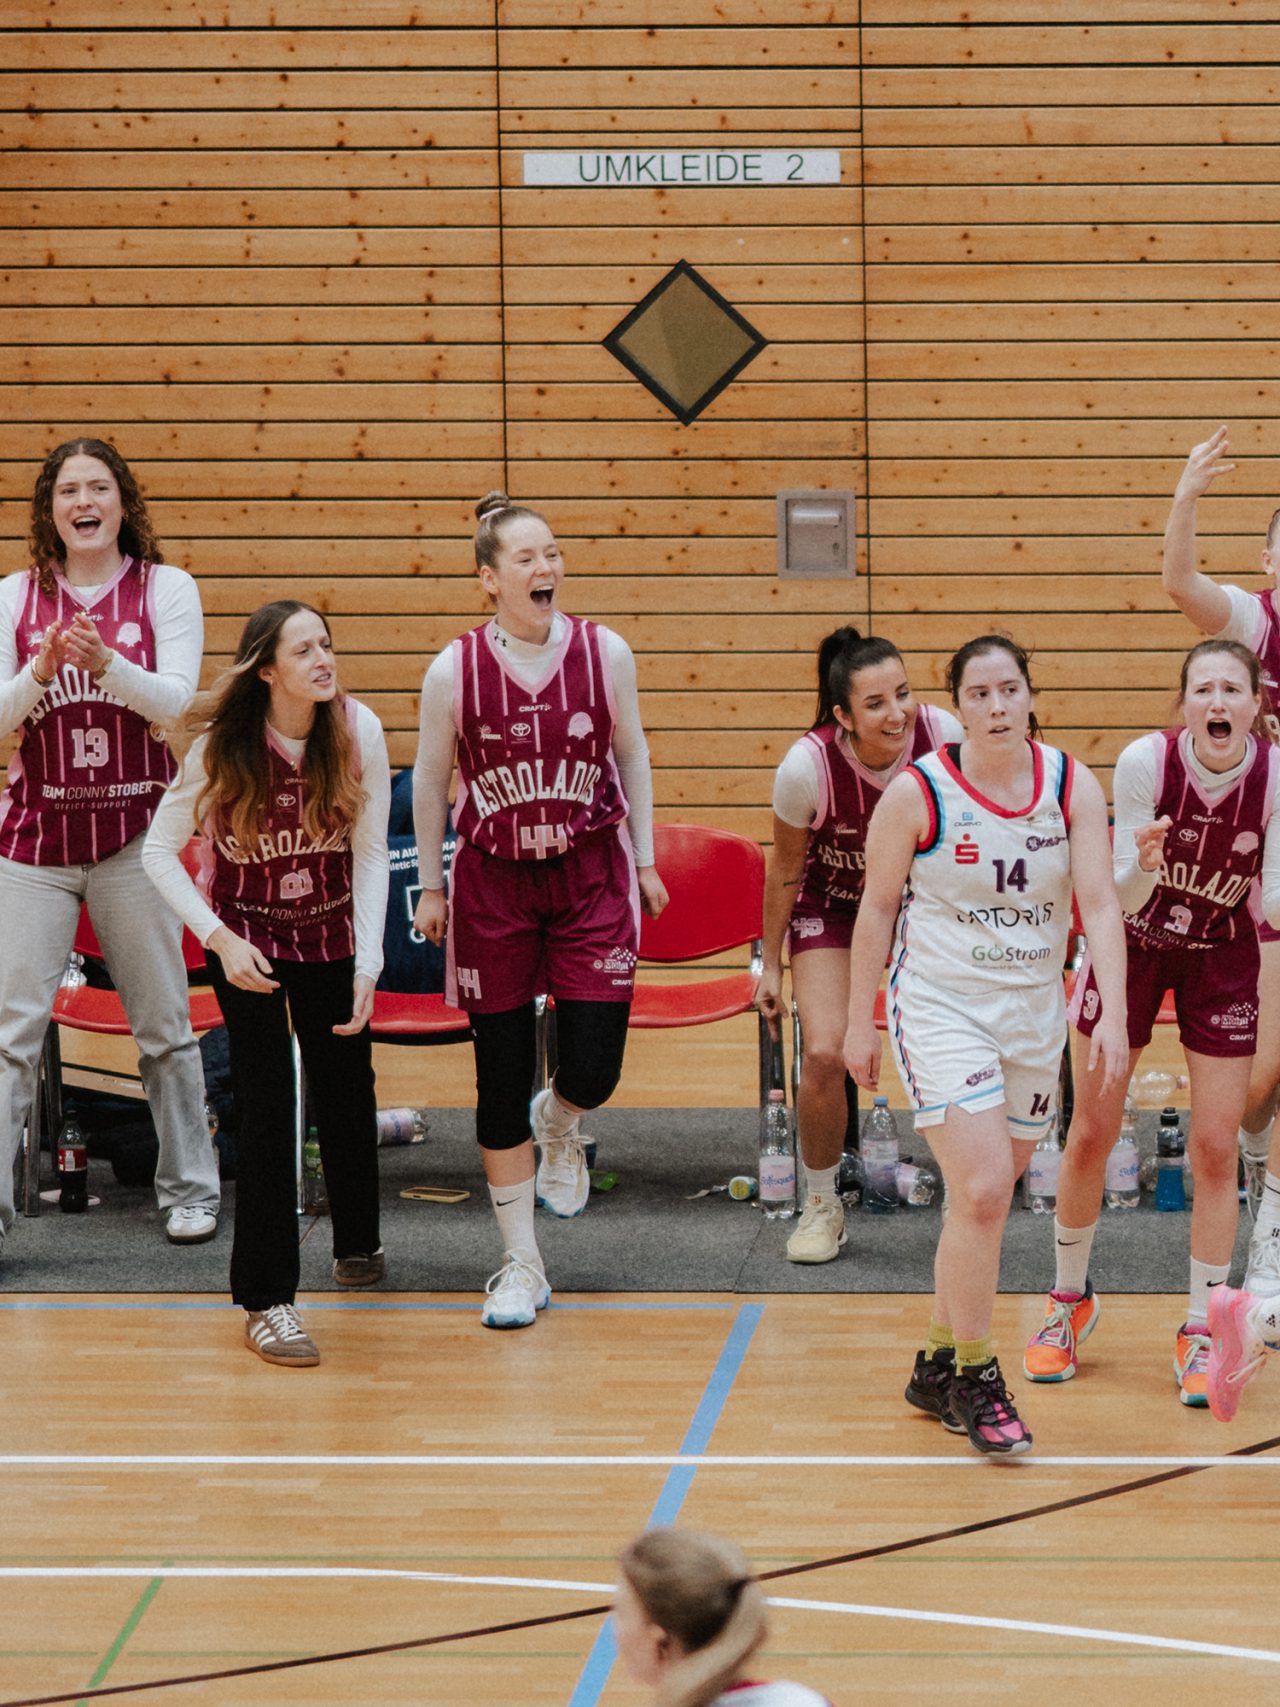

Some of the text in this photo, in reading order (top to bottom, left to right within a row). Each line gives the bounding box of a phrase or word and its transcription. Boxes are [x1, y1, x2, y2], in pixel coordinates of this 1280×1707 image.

[578, 154, 805, 182] UMKLEIDE 2
[518, 704, 545, 712] CRAFT
[71, 728, 110, 768] 13
[42, 780, 152, 801] TEAM CONNY STOBER
[1191, 814, 1218, 823] CRAFT
[519, 823, 569, 860] 44
[991, 858, 1029, 894] 14
[1163, 904, 1194, 936] 3
[457, 966, 483, 1000] 44
[1082, 988, 1100, 1021] 3
[1029, 1092, 1051, 1117] 14
